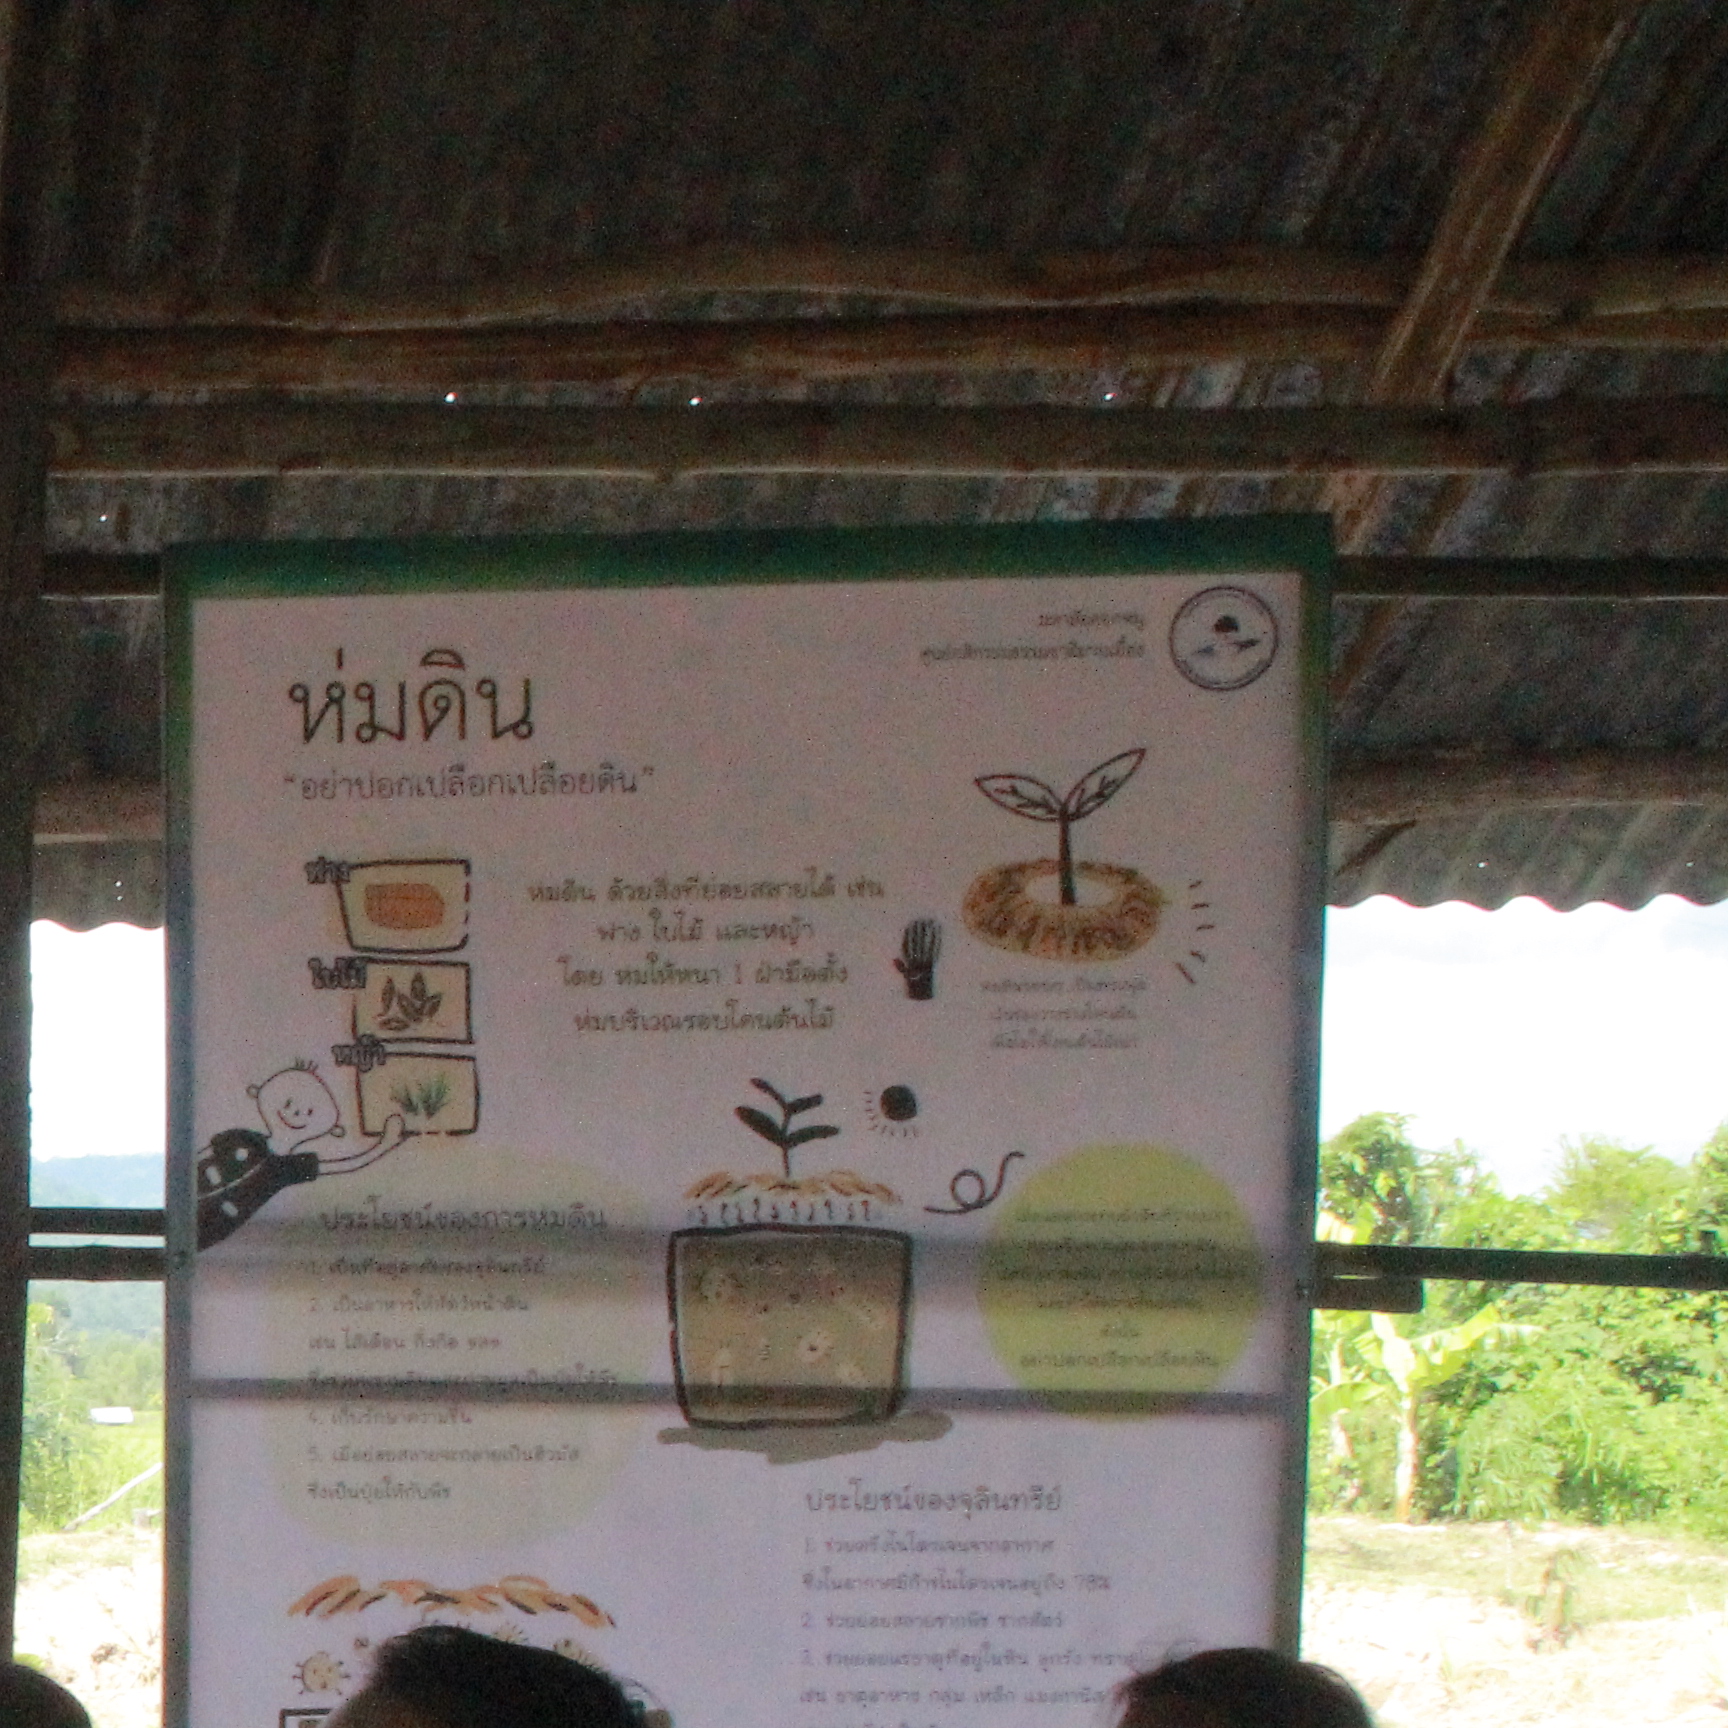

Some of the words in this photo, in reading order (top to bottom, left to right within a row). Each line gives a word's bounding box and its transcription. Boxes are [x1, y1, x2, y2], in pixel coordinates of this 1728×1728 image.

[287, 647, 536, 745] ห่มดิน
[805, 1478, 1064, 1525] ประโยชน์ของจุลินทรีย์
